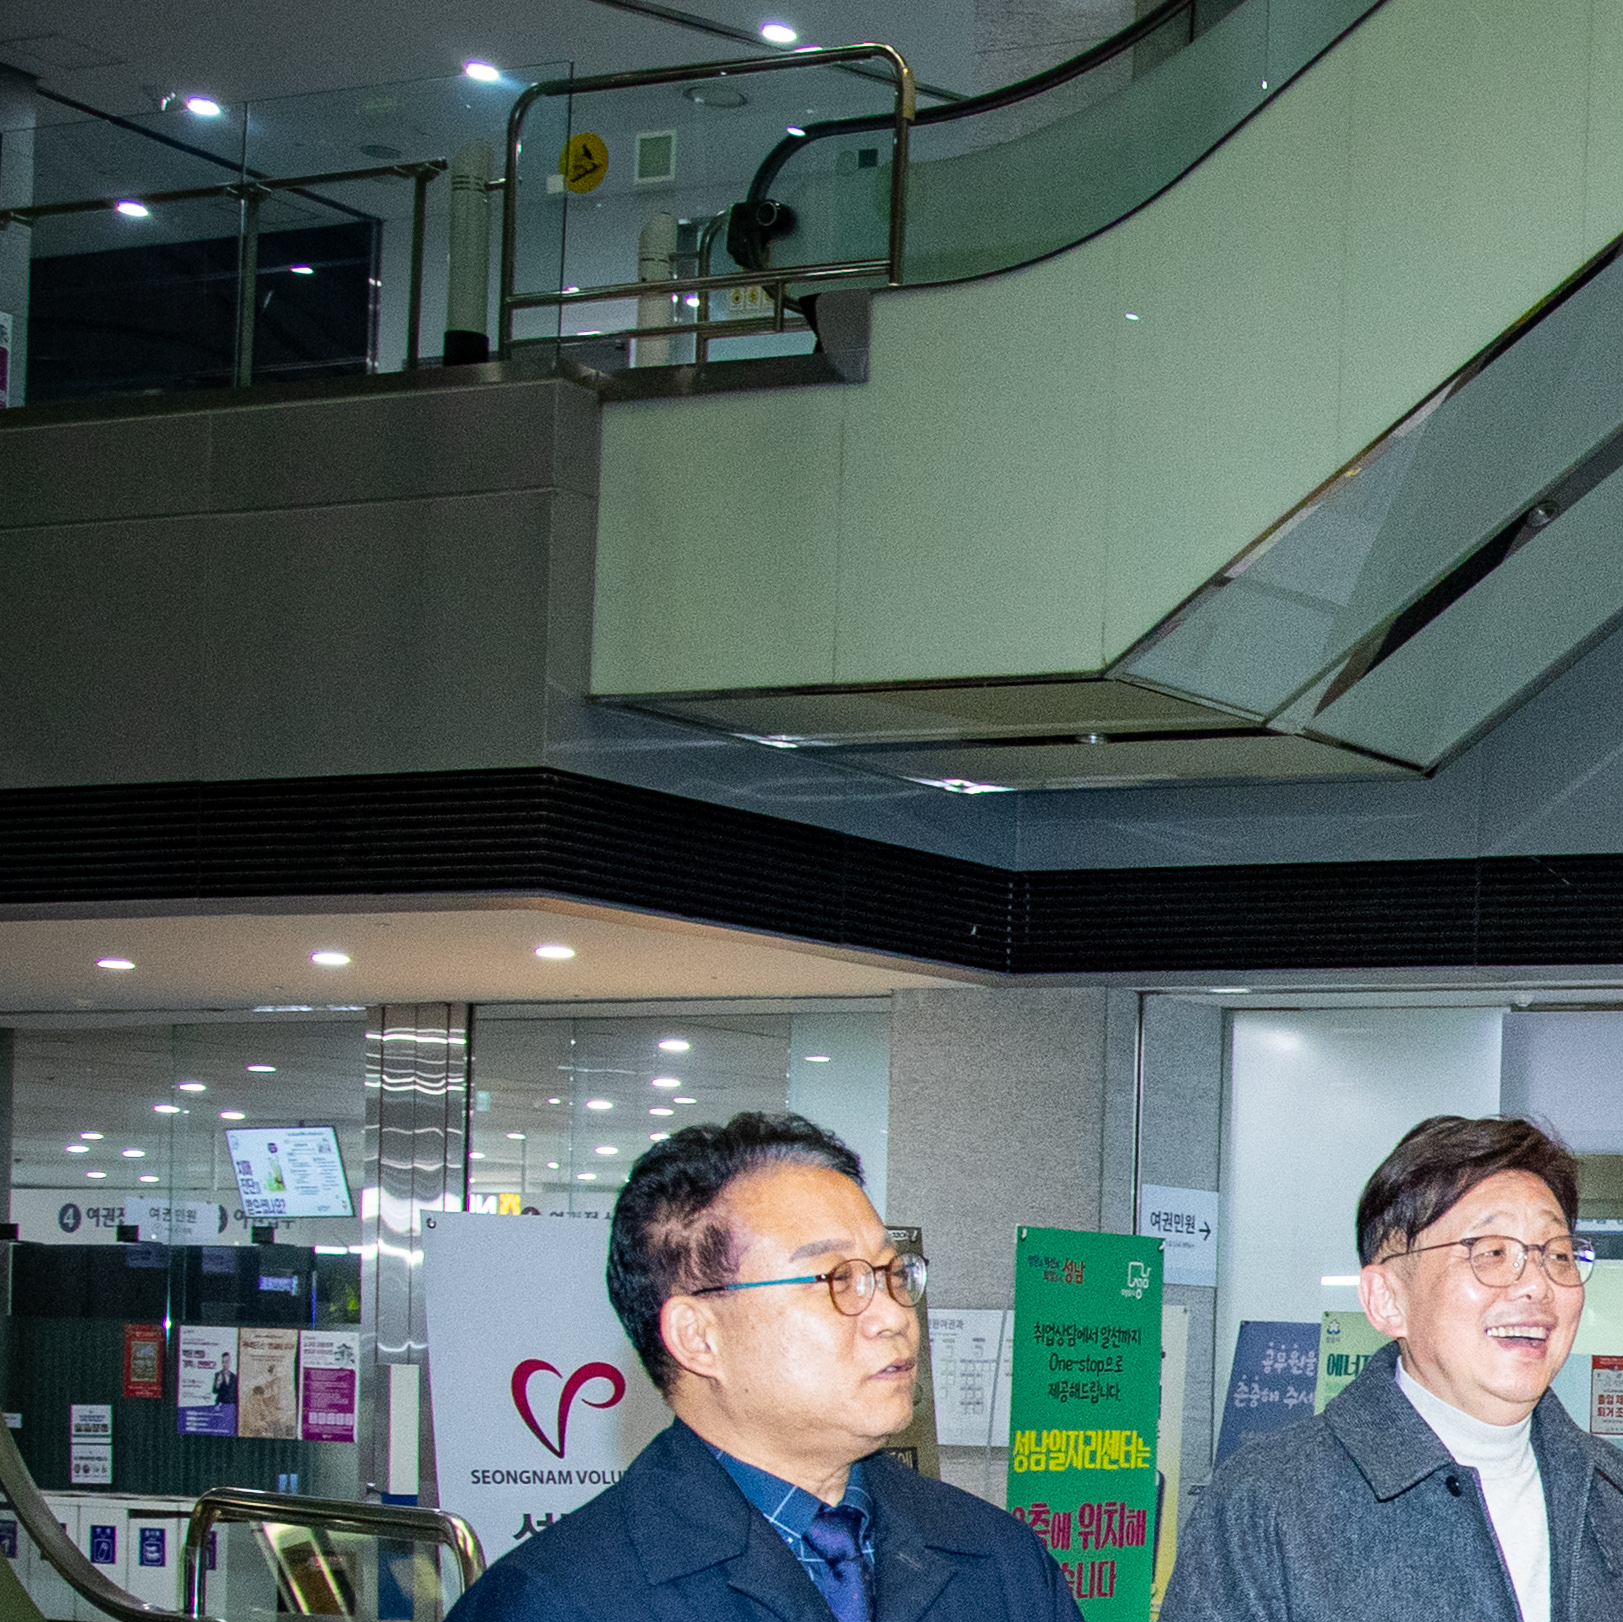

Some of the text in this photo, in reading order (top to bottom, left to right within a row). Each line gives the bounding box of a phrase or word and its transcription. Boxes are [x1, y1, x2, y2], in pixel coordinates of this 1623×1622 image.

[1150, 1211, 1196, 1235] 여권민원
[1062, 1258, 1086, 1285] 성남
[1033, 1321, 1098, 1346] 취업상담에서
[1049, 1352, 1124, 1376] One-stop으로
[1261, 1349, 1317, 1377] 공무원을
[1048, 1380, 1122, 1403] 제공해드립니다.
[1233, 1380, 1280, 1409] 존중해
[1012, 1429, 1151, 1473] 성남일자리센터는
[470, 1469, 626, 1486] SEONGNAM VOLU
[1077, 1501, 1148, 1551] 위치해
